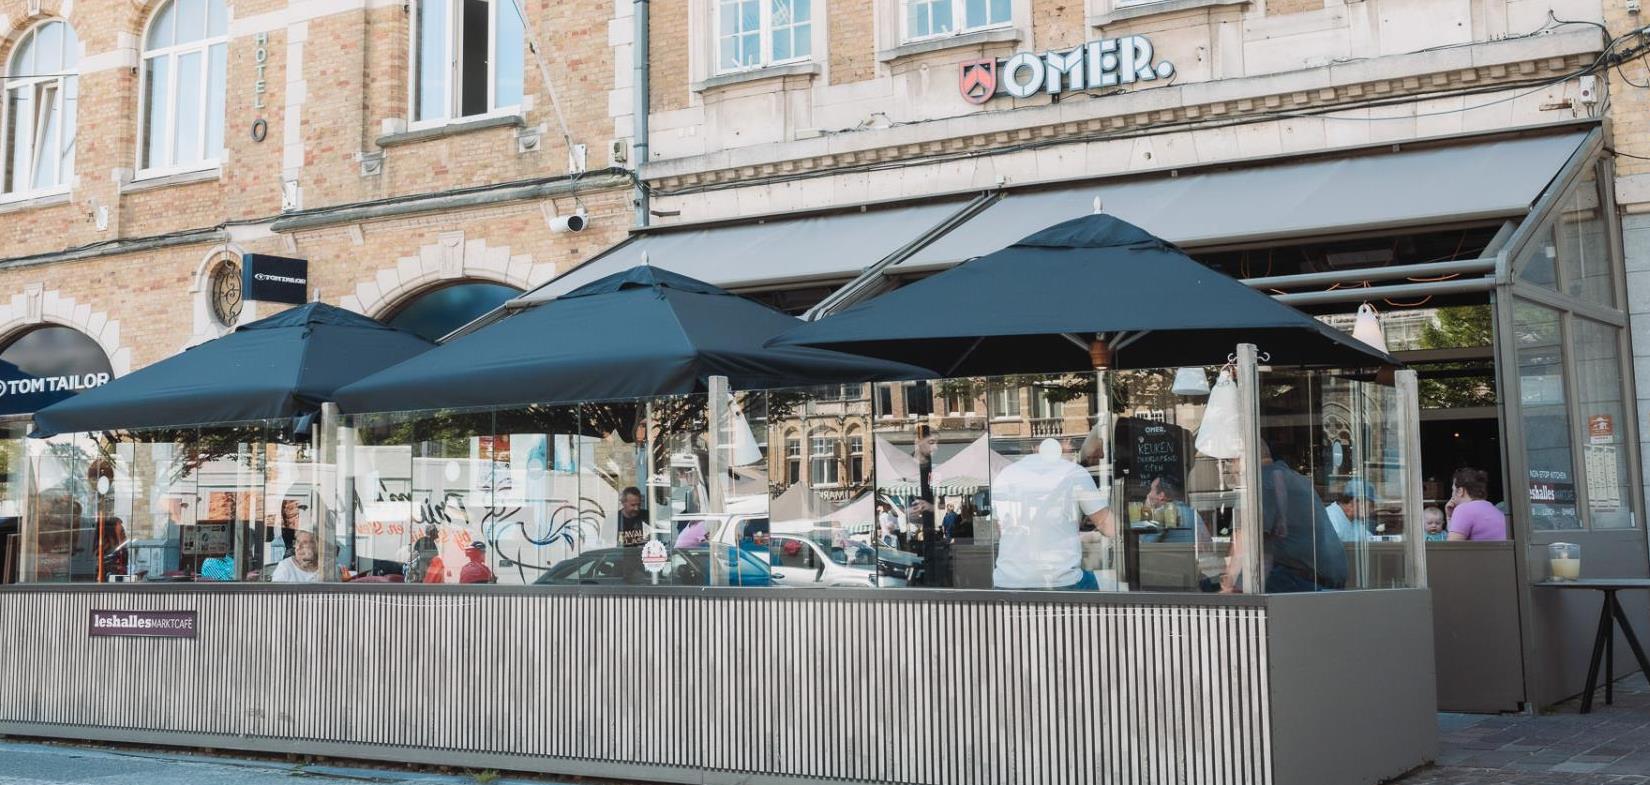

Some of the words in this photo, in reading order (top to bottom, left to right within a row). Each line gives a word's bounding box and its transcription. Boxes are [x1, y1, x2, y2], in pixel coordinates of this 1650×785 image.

[1003, 34, 1176, 98] OMER.
[7, 377, 45, 395] TOM
[46, 372, 110, 392] TAILOR
[1137, 442, 1174, 455] KEUKEN
